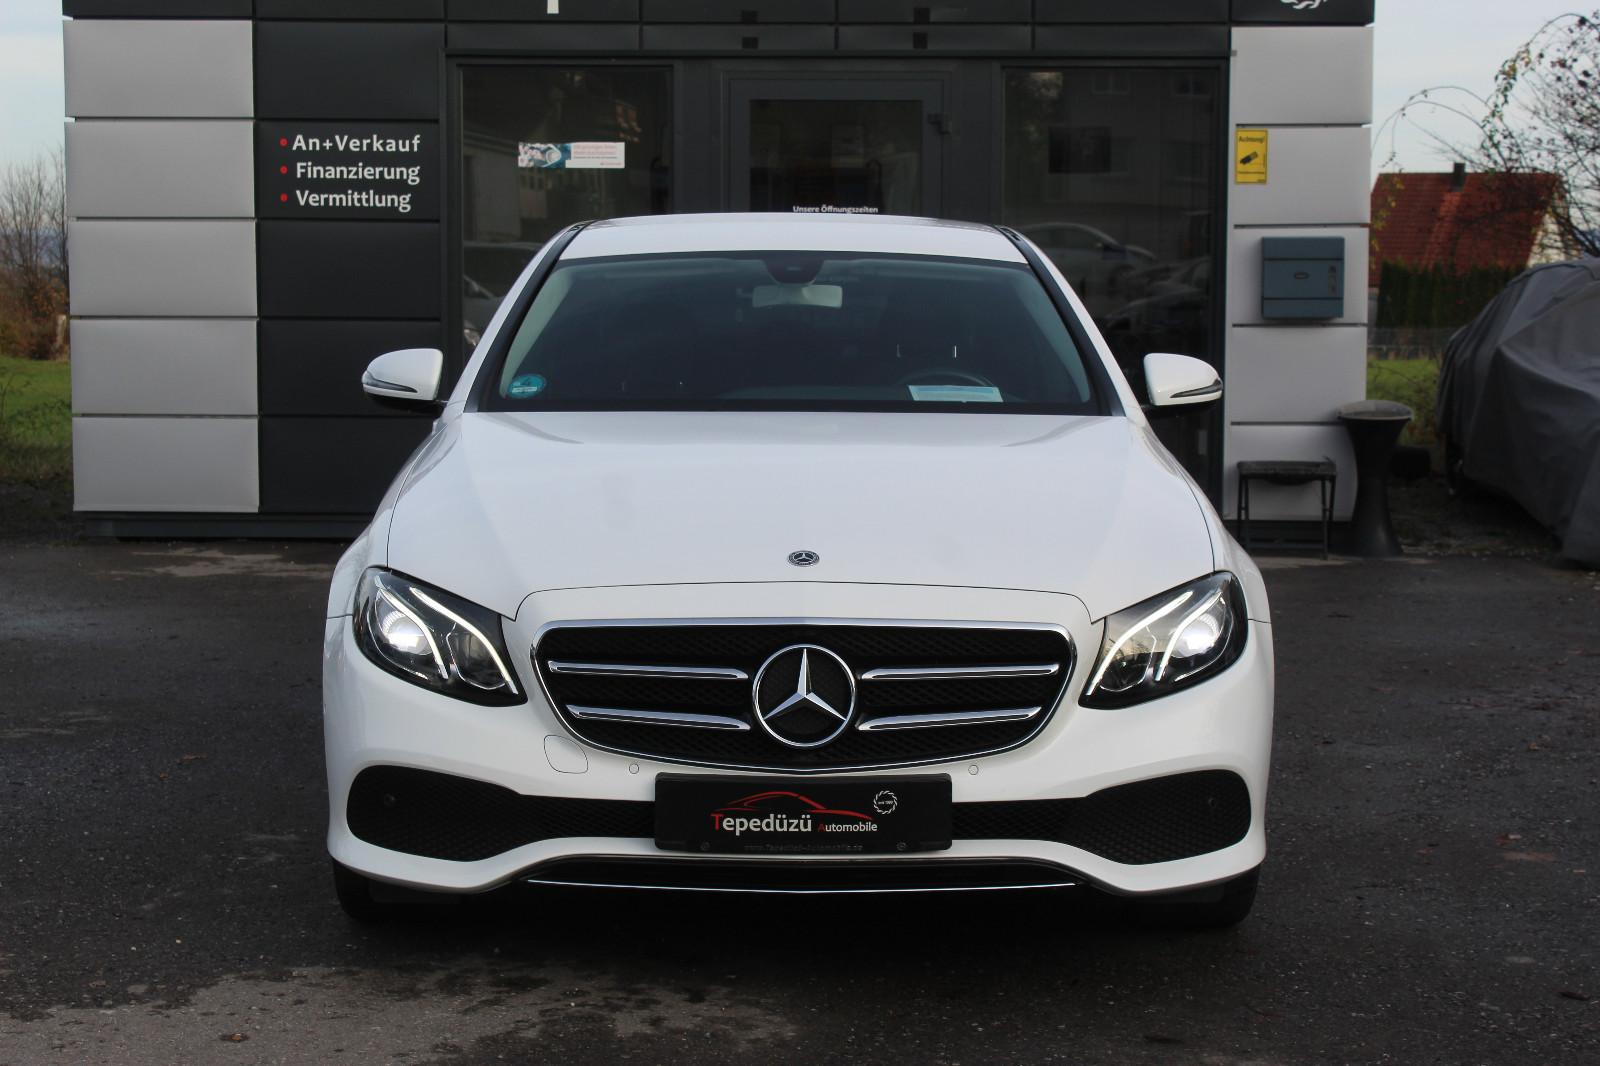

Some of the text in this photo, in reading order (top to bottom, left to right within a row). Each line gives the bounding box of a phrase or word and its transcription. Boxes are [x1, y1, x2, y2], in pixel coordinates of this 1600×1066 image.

[292, 134, 421, 152] An+Verkauf
[296, 161, 421, 185] Finanzierung
[295, 189, 412, 213] Vermittlung
[792, 203, 879, 214] Unsere Öffnungszeiten
[710, 812, 878, 836] Tepedüzü Automobile
